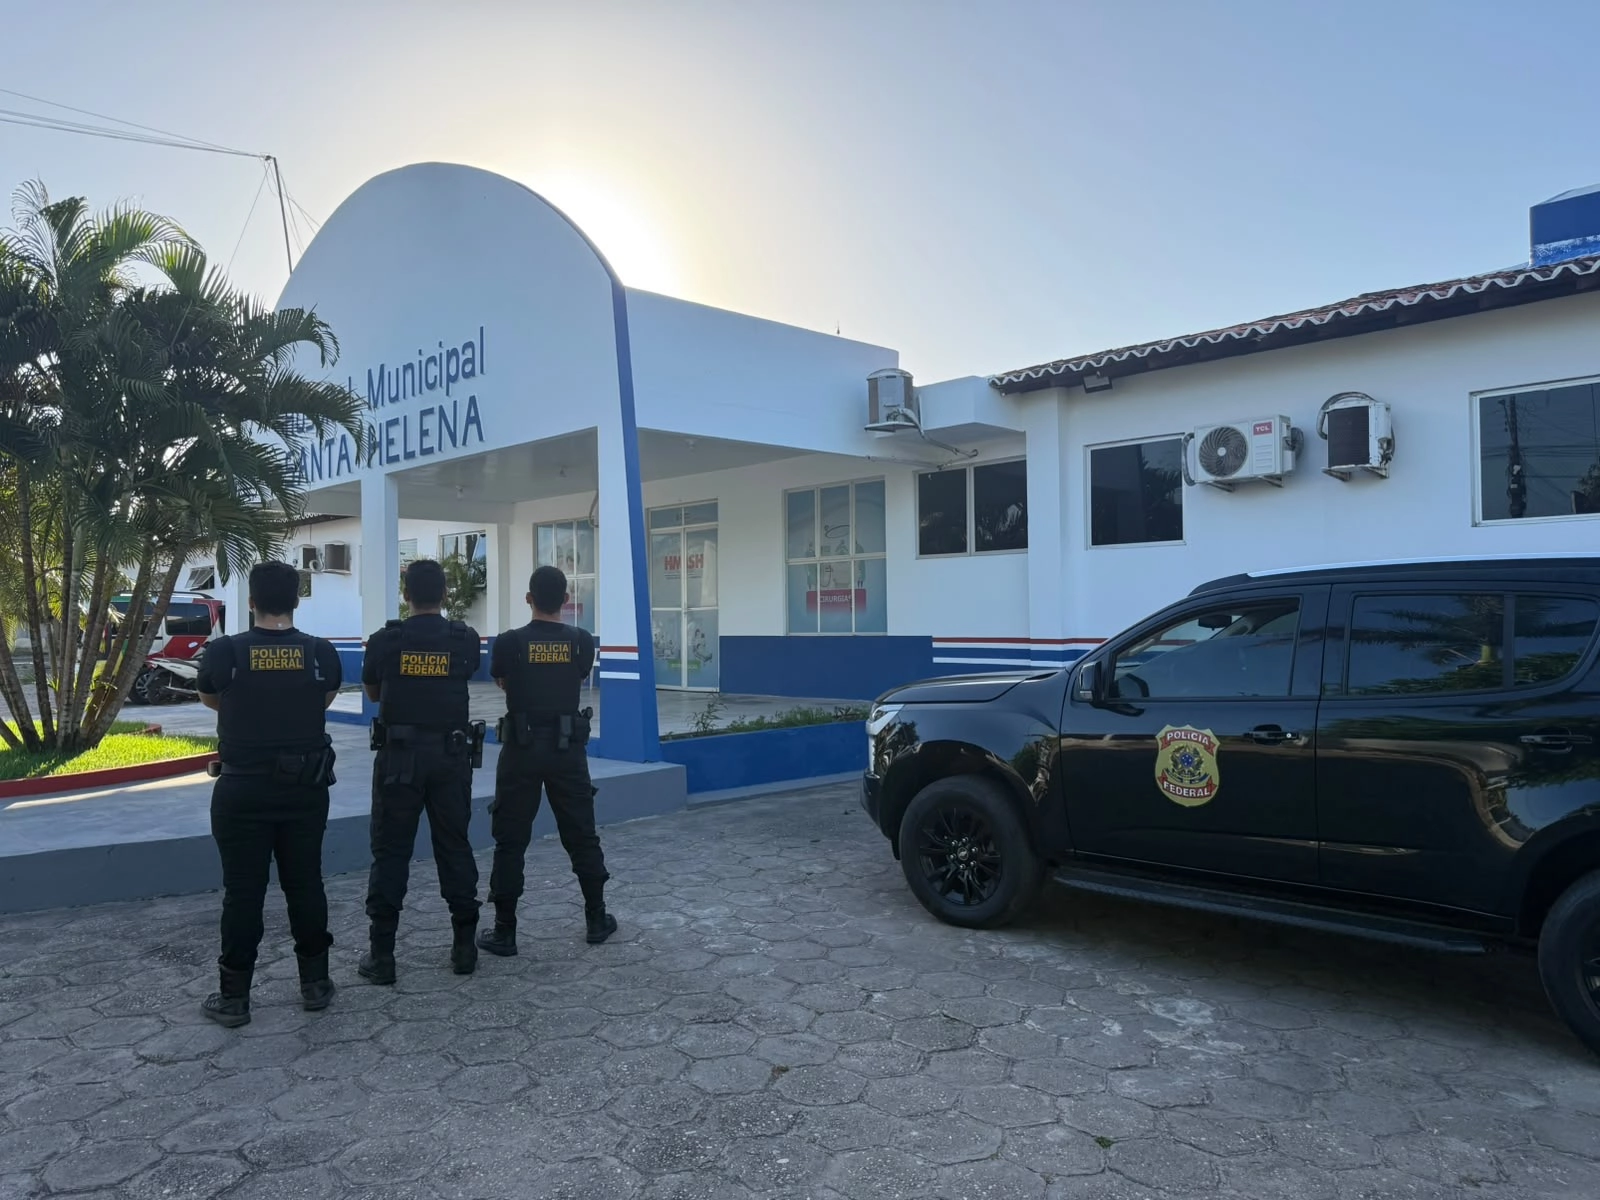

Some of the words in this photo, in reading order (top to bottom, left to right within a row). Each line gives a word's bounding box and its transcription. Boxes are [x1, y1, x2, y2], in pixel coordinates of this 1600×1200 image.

[367, 326, 485, 411] Municipal
[367, 395, 485, 467] HELENA
[251, 645, 302, 658] POLÍCIA
[529, 652, 569, 662] FEDERAL
[251, 658, 303, 669] FEDERAL
[402, 653, 448, 665] POLÍCIA
[401, 664, 448, 675] FEDERAL
[1163, 781, 1211, 797] FEDERAL
